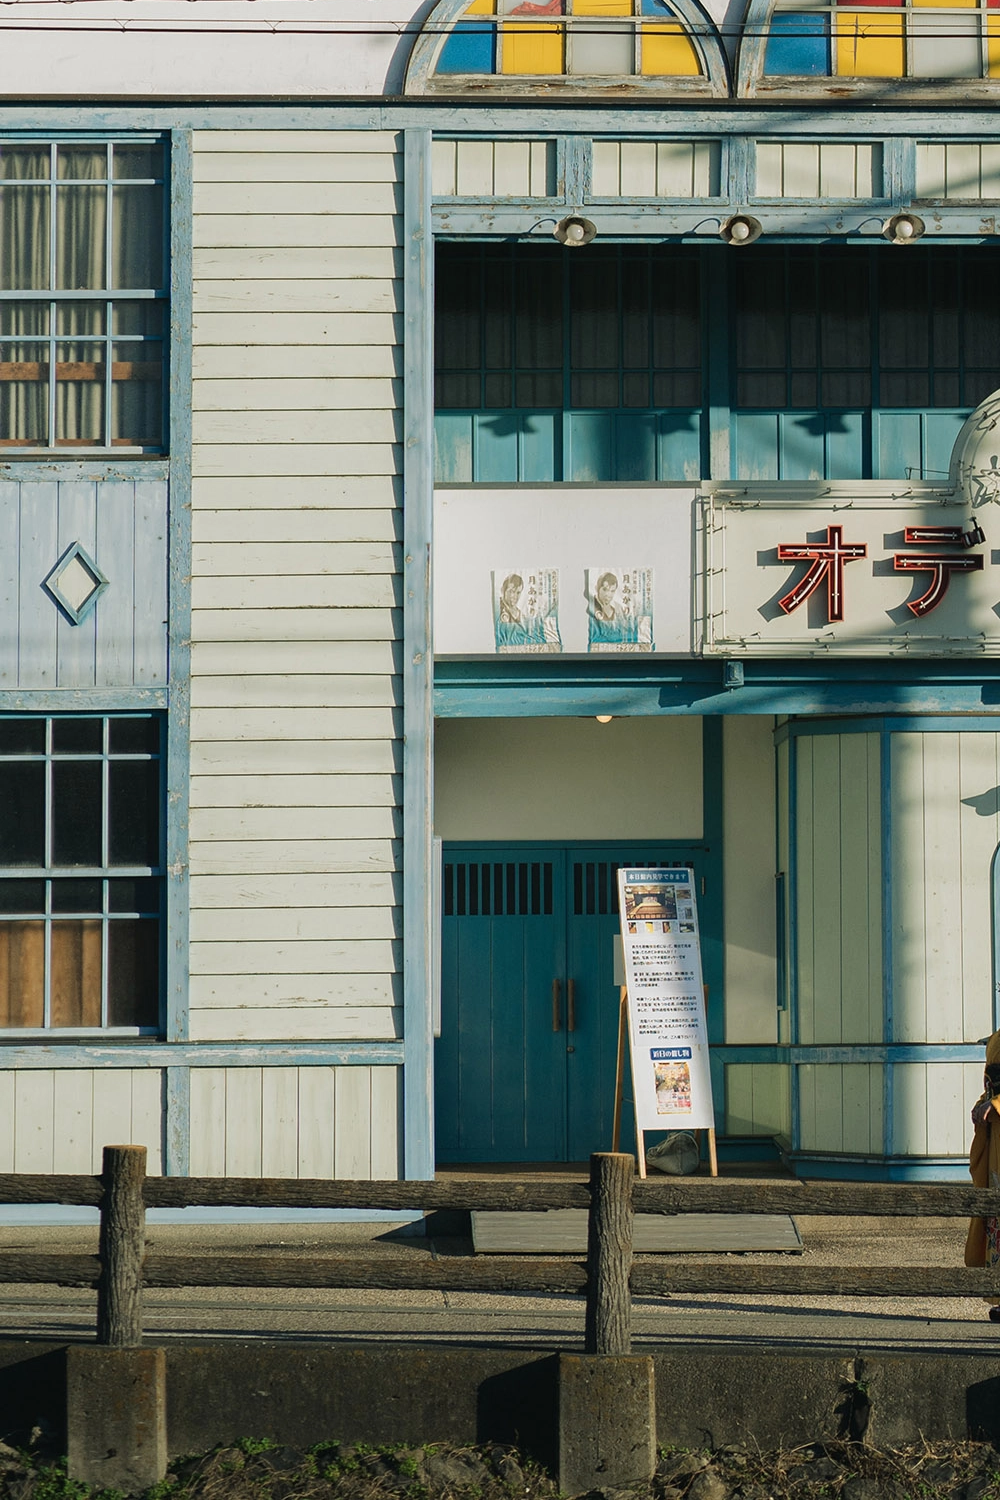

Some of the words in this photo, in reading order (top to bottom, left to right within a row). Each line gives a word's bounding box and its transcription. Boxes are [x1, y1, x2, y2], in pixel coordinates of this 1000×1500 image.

[527, 575, 537, 616] 月あかり
[621, 573, 632, 615] 月あかり
